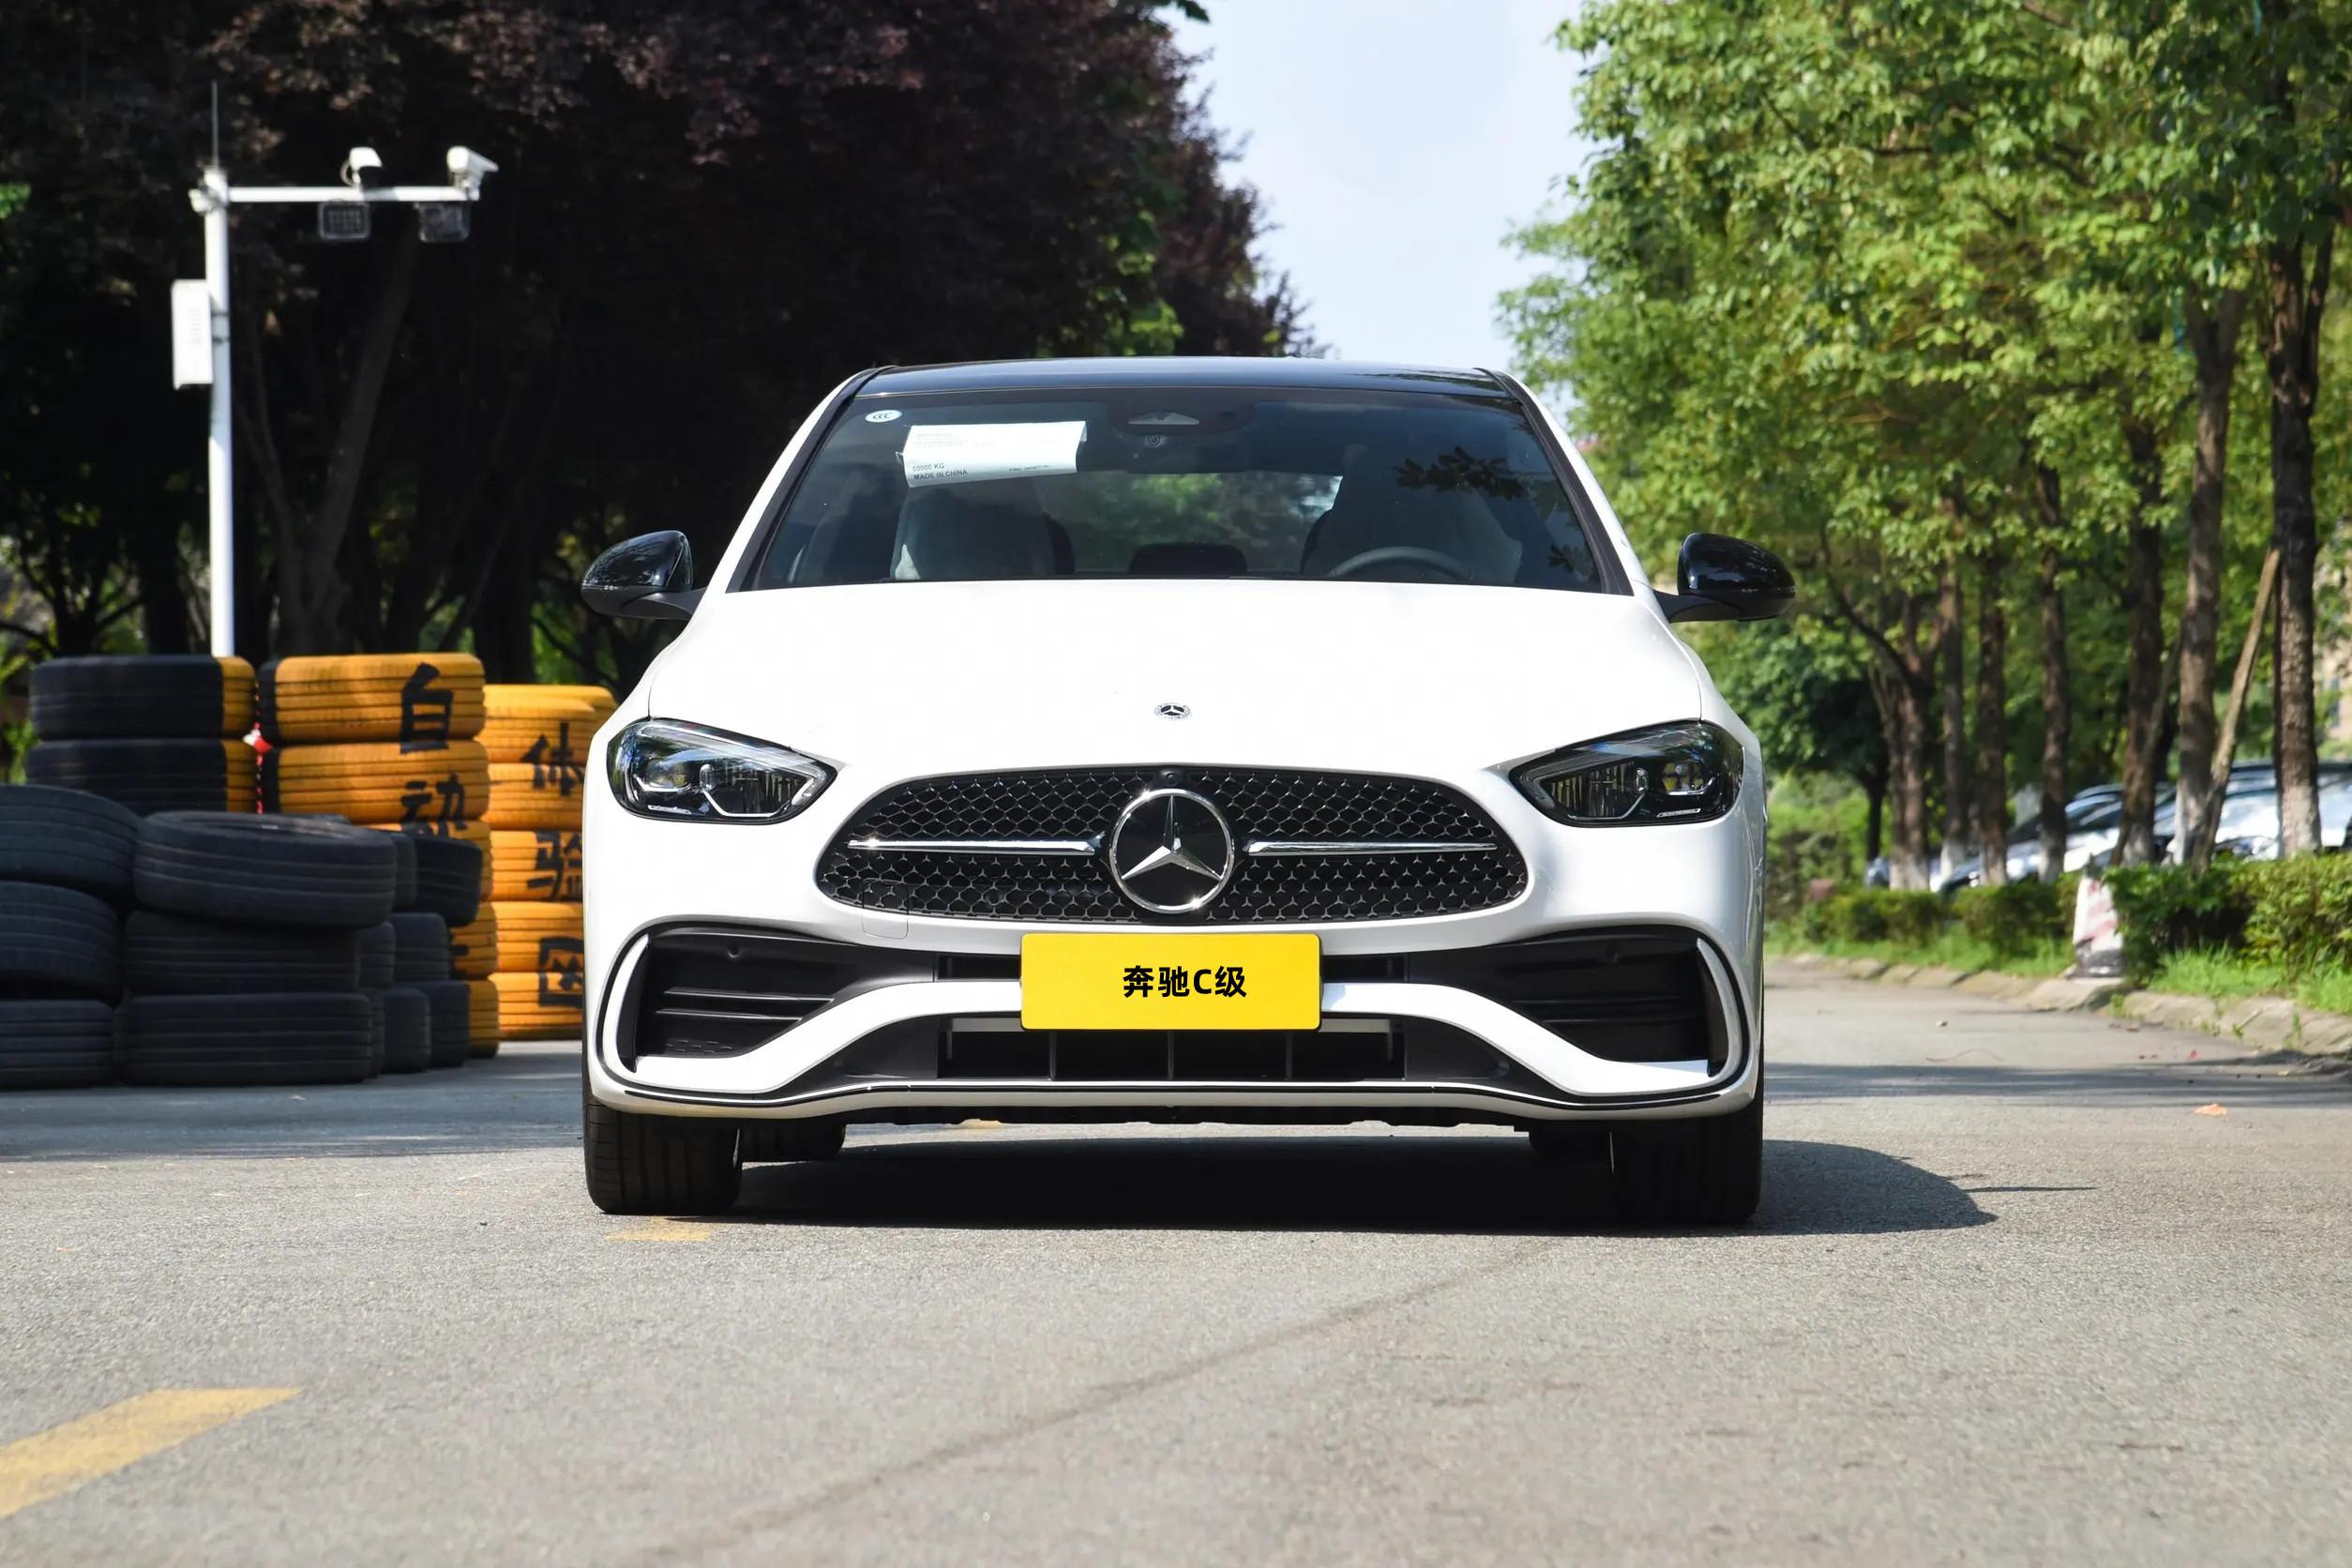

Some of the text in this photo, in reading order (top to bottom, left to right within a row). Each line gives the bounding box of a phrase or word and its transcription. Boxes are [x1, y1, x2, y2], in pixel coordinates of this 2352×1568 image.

[945, 469, 969, 477] CHINA
[1123, 965, 1247, 998] 奔驰C级
